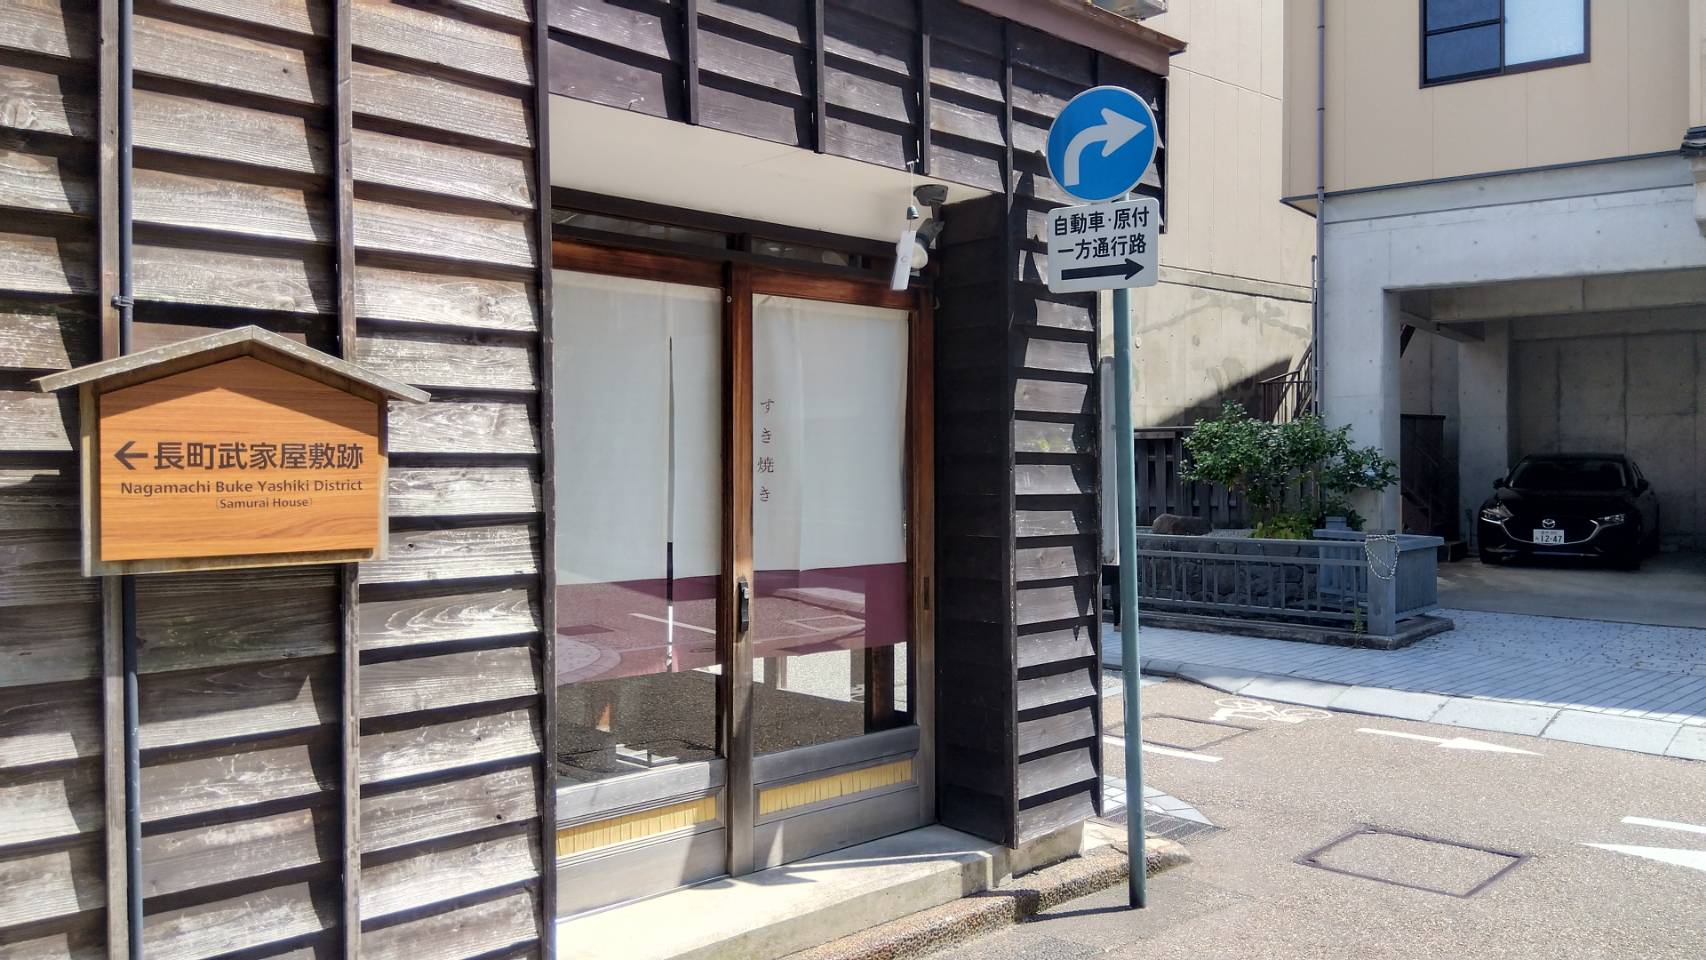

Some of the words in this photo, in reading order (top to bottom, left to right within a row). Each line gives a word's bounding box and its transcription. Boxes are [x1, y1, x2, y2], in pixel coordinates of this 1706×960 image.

[1057, 233, 1147, 260] 一方通行路
[154, 442, 364, 470] 長町武家屋敷跡
[758, 399, 775, 502] すき焼き
[121, 481, 211, 497] Nagamachi
[215, 480, 253, 493] Buke
[257, 480, 310, 492] Yashiki
[314, 479, 363, 491] District
